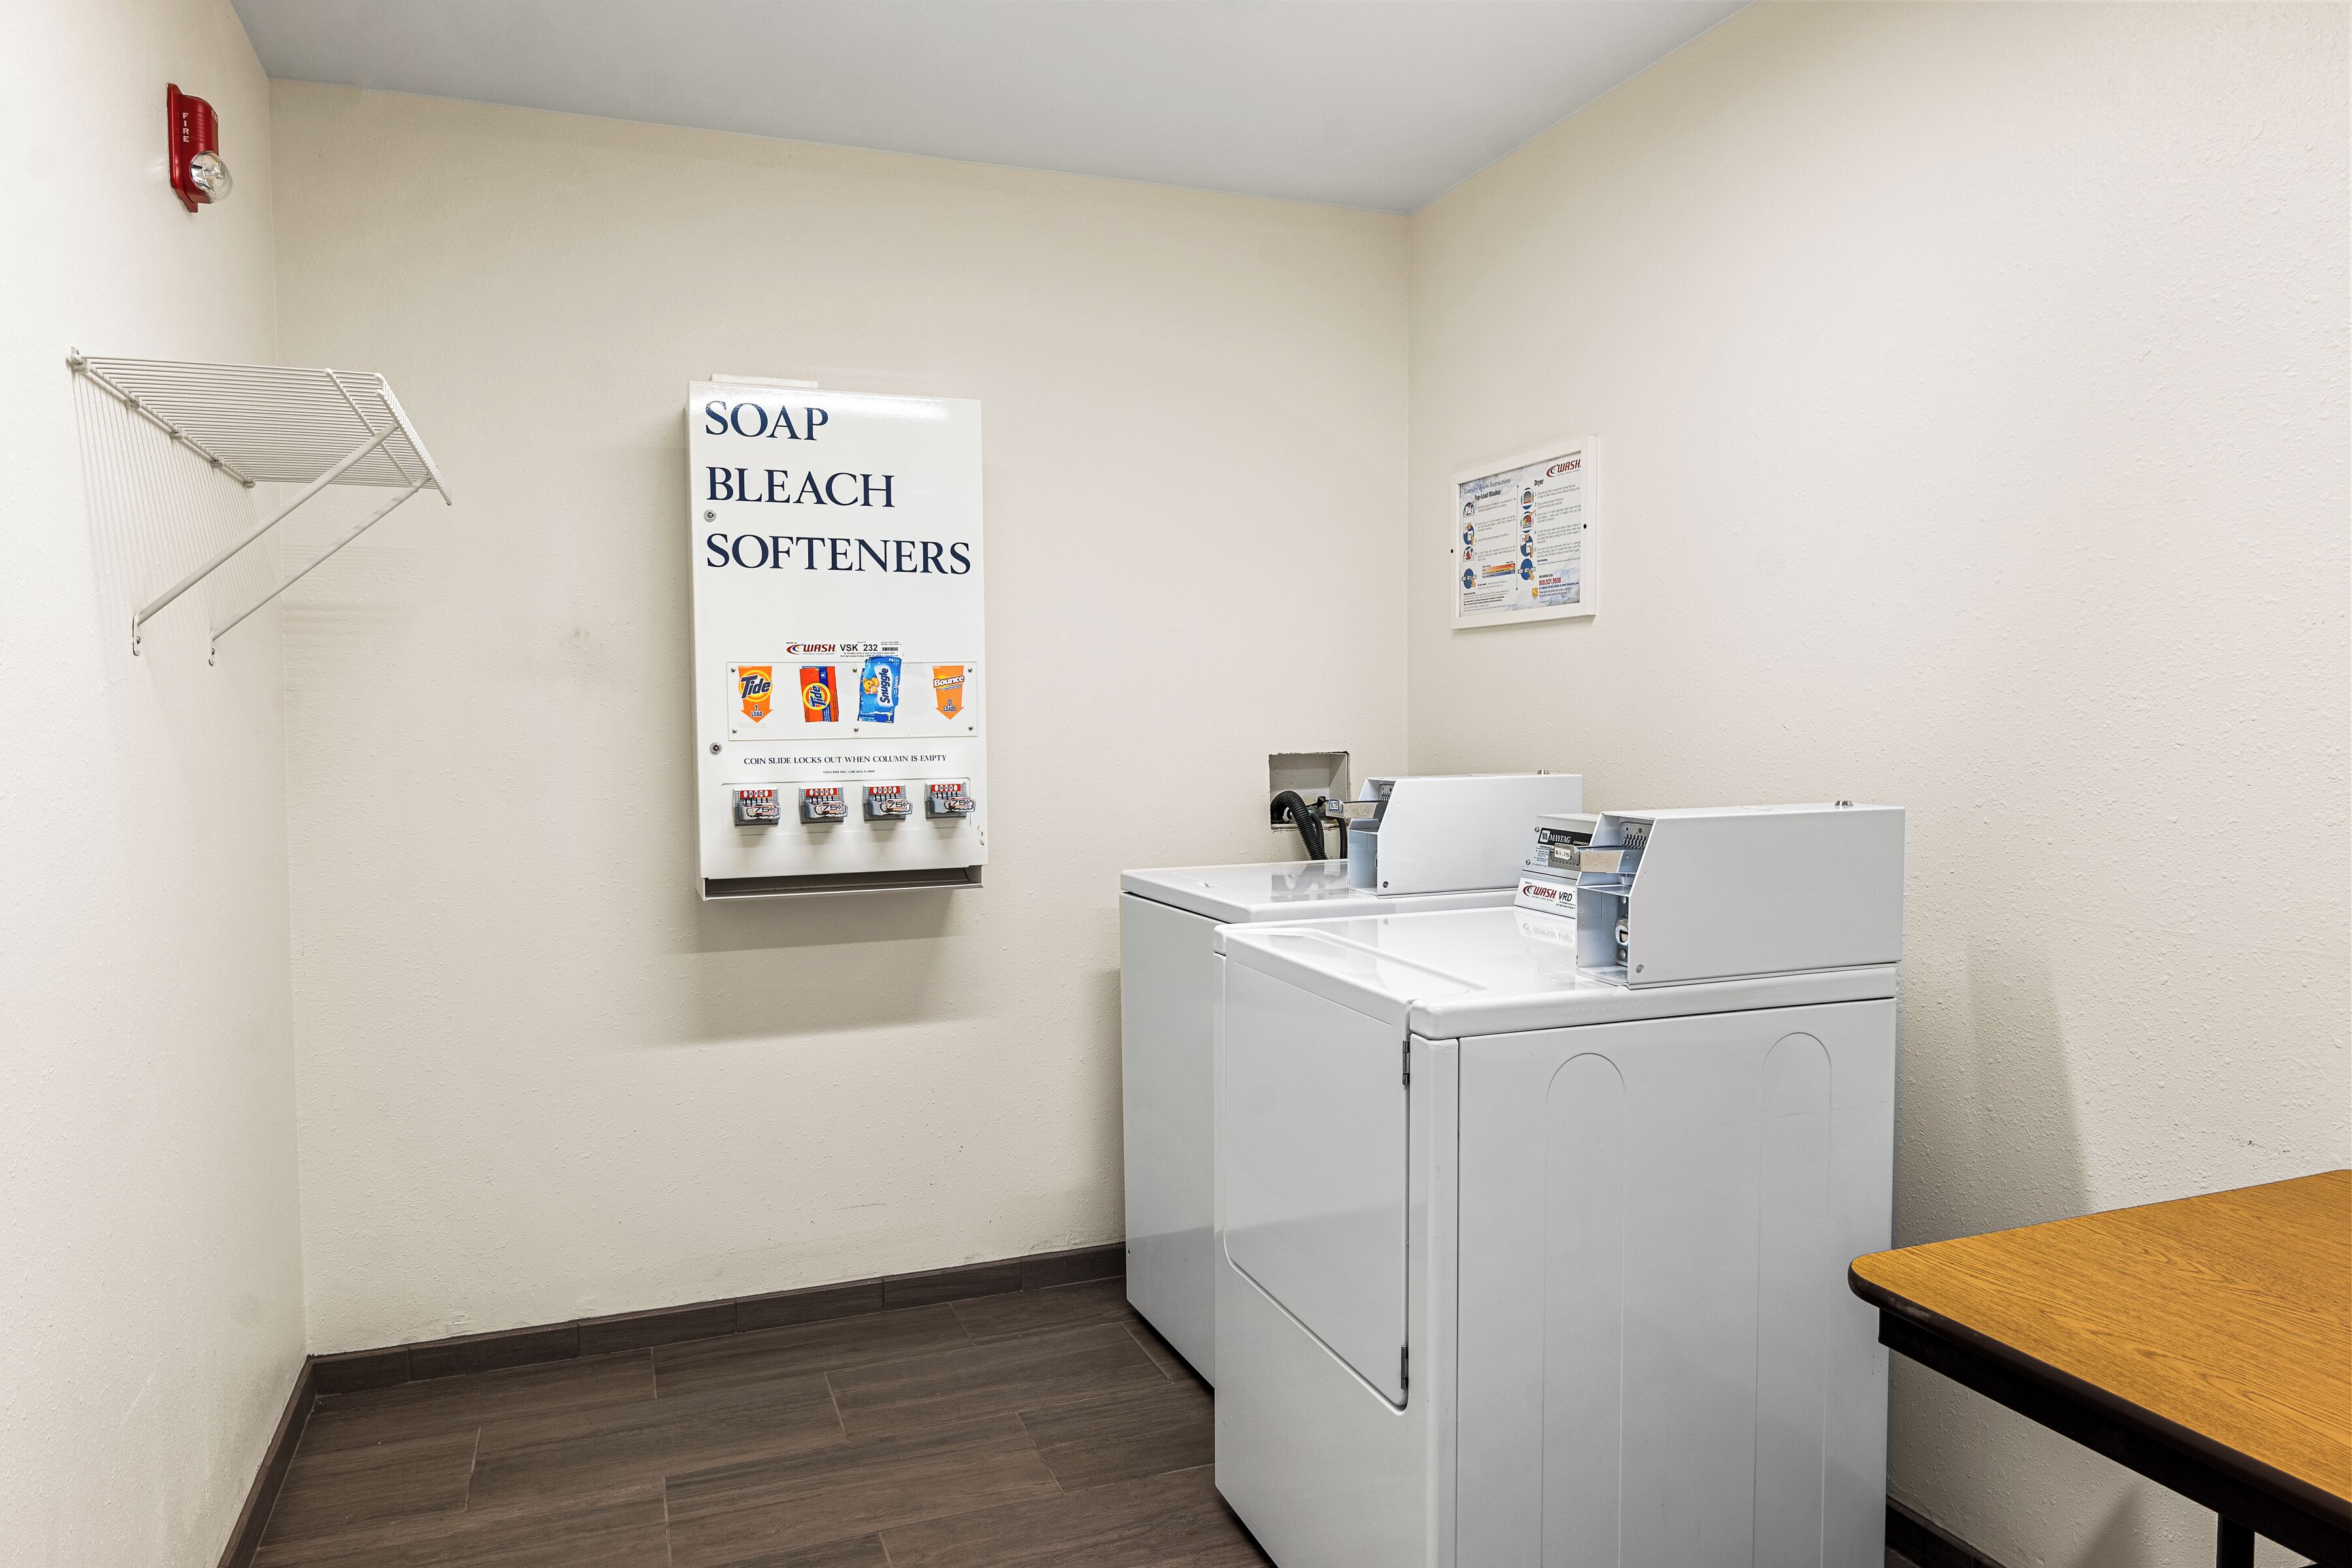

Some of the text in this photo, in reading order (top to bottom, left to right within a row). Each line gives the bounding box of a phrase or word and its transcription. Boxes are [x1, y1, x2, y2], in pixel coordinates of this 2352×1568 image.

[705, 400, 828, 441] SOAP
[1557, 459, 1581, 473] WASH
[706, 466, 896, 508] BLEACH
[1490, 478, 1511, 488] Instructions
[1474, 492, 1488, 502] Top-Load
[706, 532, 971, 576] SOFTENERS
[741, 674, 772, 699] Tide
[879, 668, 890, 704] Snuggle
[934, 676, 964, 687] Bounce
[809, 685, 826, 708] Tide
[1548, 834, 1571, 843] MAYTAG
[1533, 886, 1557, 899] WASH
[1559, 891, 1573, 902] VRD
